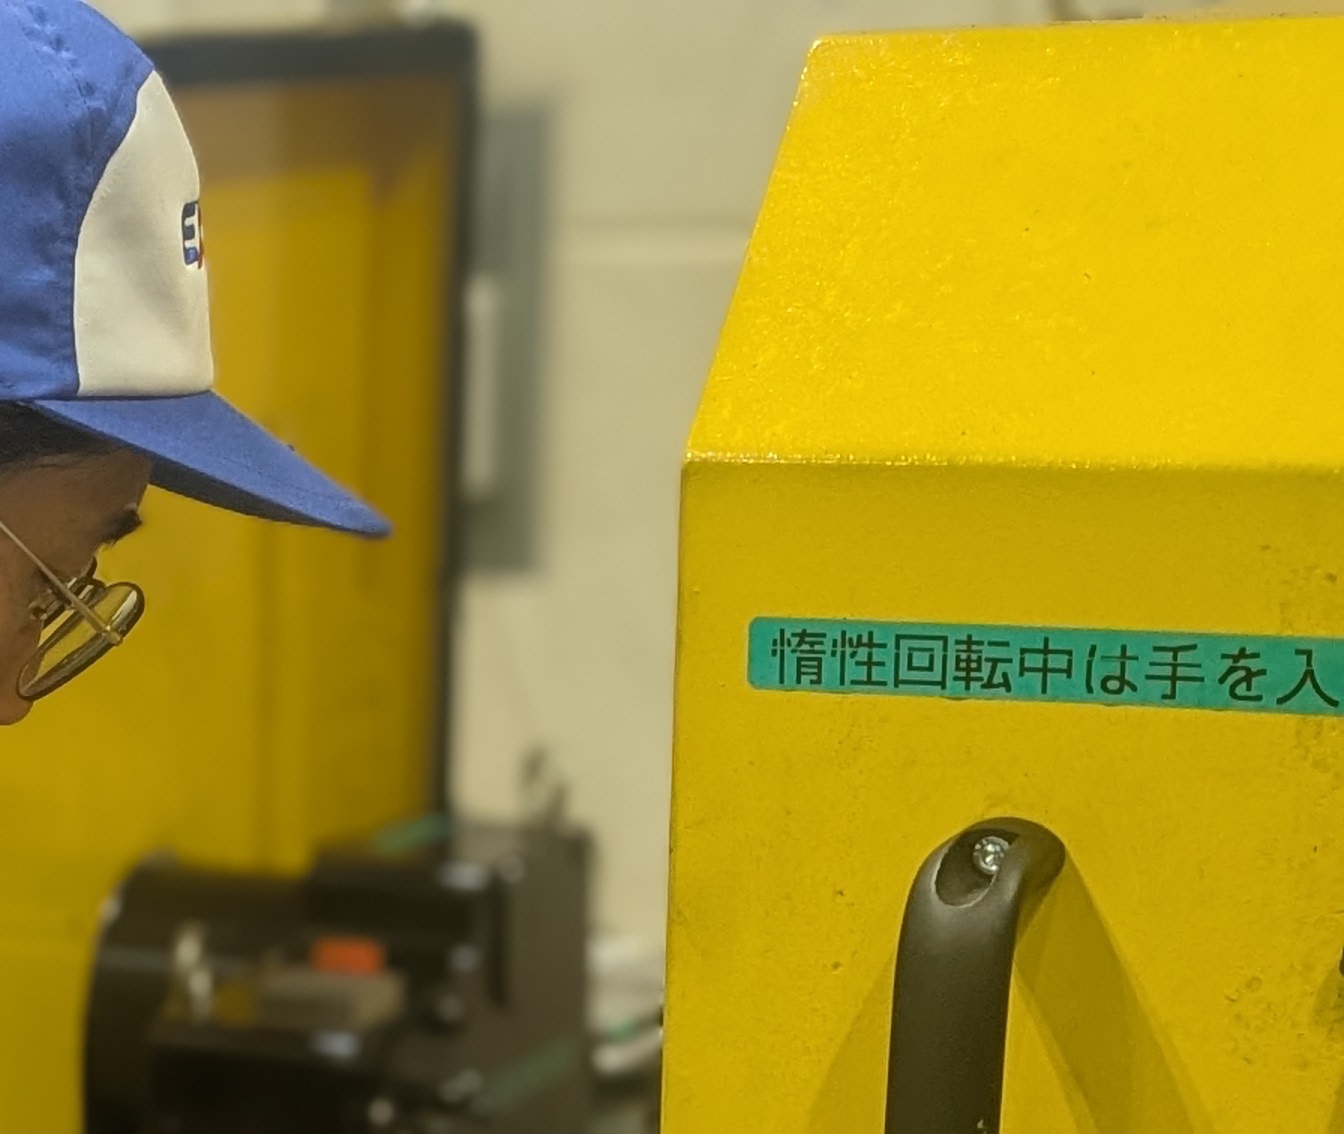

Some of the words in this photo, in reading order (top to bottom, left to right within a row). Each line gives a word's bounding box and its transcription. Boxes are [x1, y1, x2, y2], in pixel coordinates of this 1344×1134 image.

[770, 628, 1341, 707] 惰性回転中は手を入
